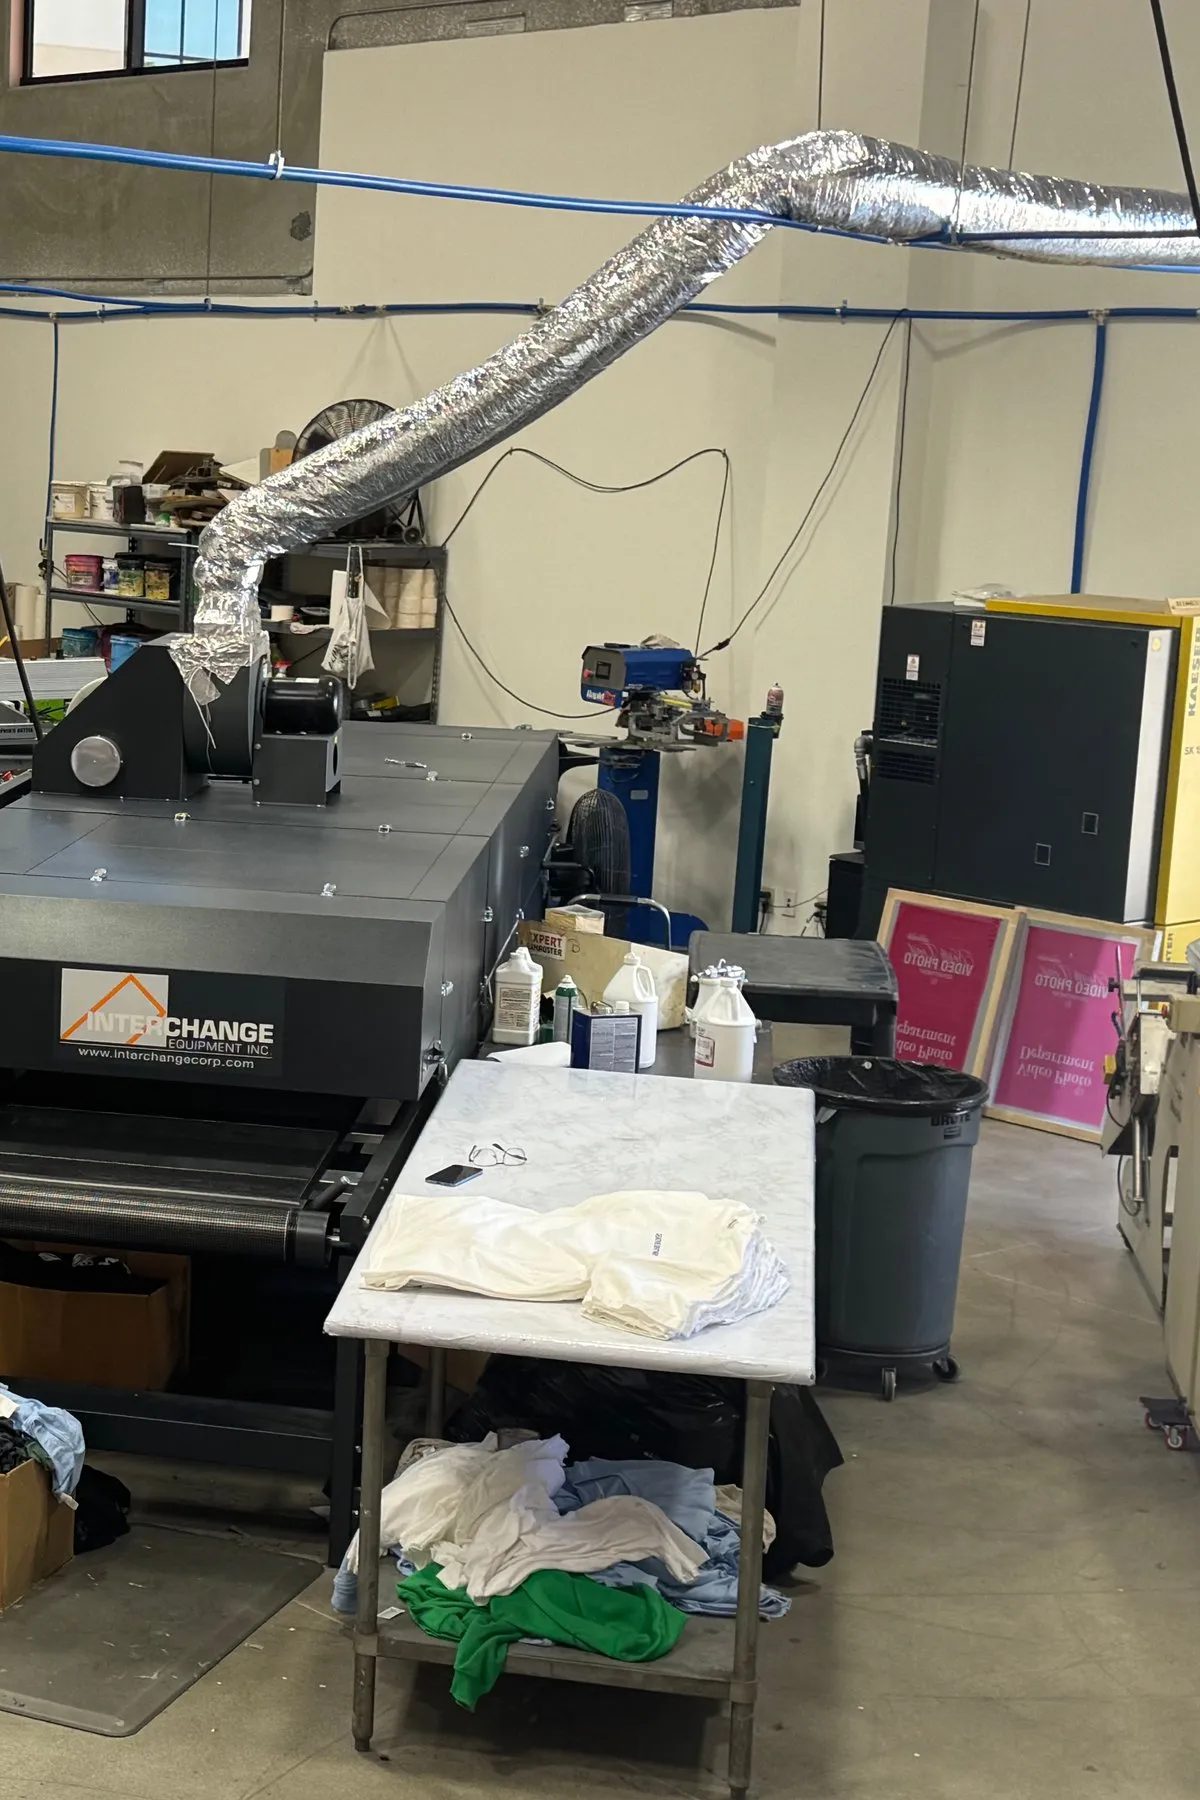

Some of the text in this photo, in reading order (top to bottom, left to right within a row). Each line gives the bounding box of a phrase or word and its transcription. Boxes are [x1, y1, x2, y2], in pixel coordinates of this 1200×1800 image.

[87, 1011, 274, 1043] INTERCHANGE
[168, 1038, 242, 1054] EQUIPMENT
[78, 1048, 255, 1069] www.interchangecorp.com
